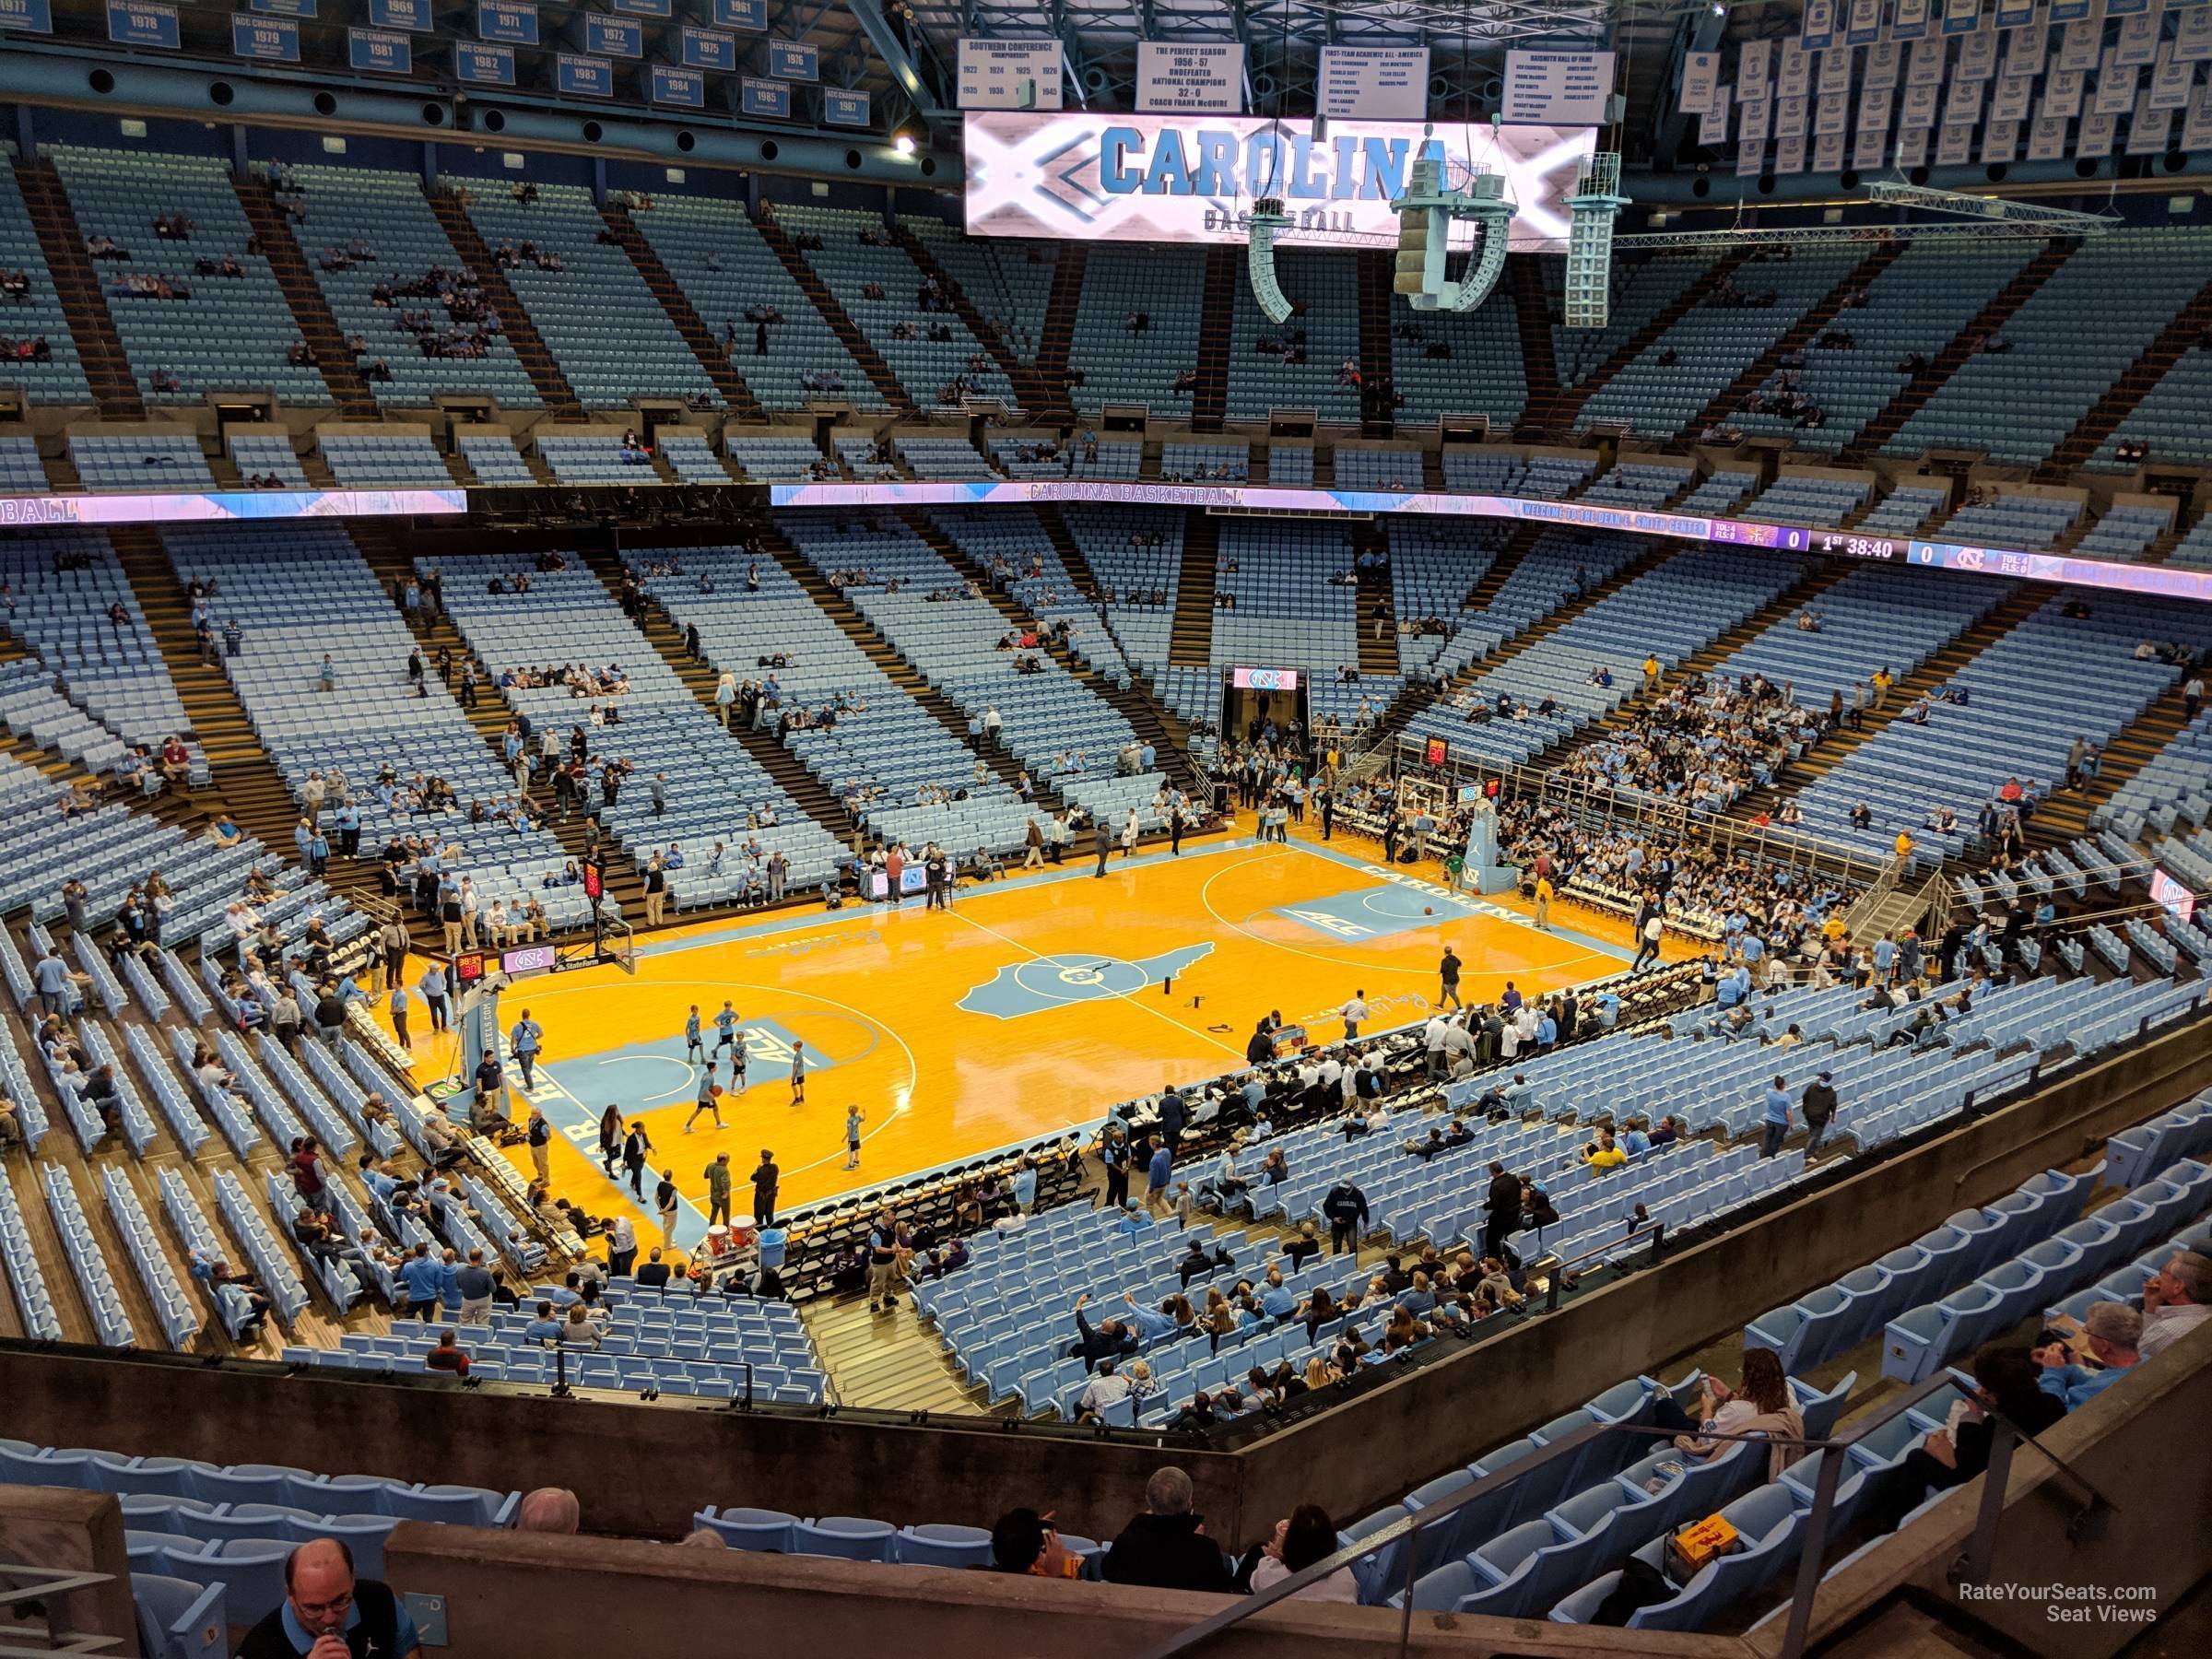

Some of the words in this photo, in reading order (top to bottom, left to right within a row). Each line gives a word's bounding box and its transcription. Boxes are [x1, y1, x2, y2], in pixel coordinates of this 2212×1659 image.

[497, 2, 535, 15] CHAMPIONS
[130, 15, 158, 29] 1978
[253, 18, 296, 30] CHAMPIONS
[499, 14, 520, 28] 1971
[604, 17, 641, 29] CHAMPIONS
[254, 29, 280, 44] 1979
[367, 32, 408, 45] CHAMPIONS
[603, 28, 625, 41] 1972
[700, 30, 733, 43] CHAMPIONS
[370, 43, 393, 56] 1981
[474, 45, 512, 58] CHAMPIONS
[700, 41, 719, 54] 1975
[785, 44, 817, 55] CHAMPIONS
[969, 41, 1006, 51] SOUTHERN
[1008, 42, 1053, 52] CONFERENCE
[475, 55, 499, 69] 1982
[574, 57, 610, 69] CHAMPIONS
[786, 53, 805, 65] 1976
[1199, 58, 1207, 66] 57
[574, 67, 596, 80] 1983
[668, 69, 700, 81] CHAMPIONS
[1016, 66, 1030, 75] 1925
[667, 79, 688, 92] 1984
[757, 82, 788, 93] CHAMPIONS
[757, 91, 777, 103] 1985
[840, 90, 868, 101] CHAMPIONS
[1179, 88, 1189, 97] 32
[1195, 88, 1201, 97] 0
[839, 100, 856, 112] 1987
[1100, 126, 1448, 199] CAROLINA
[1205, 208, 1356, 232] BASTBALL
[1030, 484, 1113, 500] CAROLINA
[1121, 486, 1243, 506] BASKETBALL
[1523, 503, 1564, 518] WELCOME
[1567, 508, 1578, 521] TO
[1581, 510, 1595, 524] THE
[1598, 512, 1621, 526] DEAN
[1635, 516, 1667, 531] SMITH
[1668, 520, 1707, 535] CENTER
[1789, 531, 1800, 547] 0
[1822, 535, 1842, 551] 1ST
[1846, 538, 1892, 559] 38:40
[1921, 546, 1933, 563] 0
[1283, 908, 1376, 935] ACC
